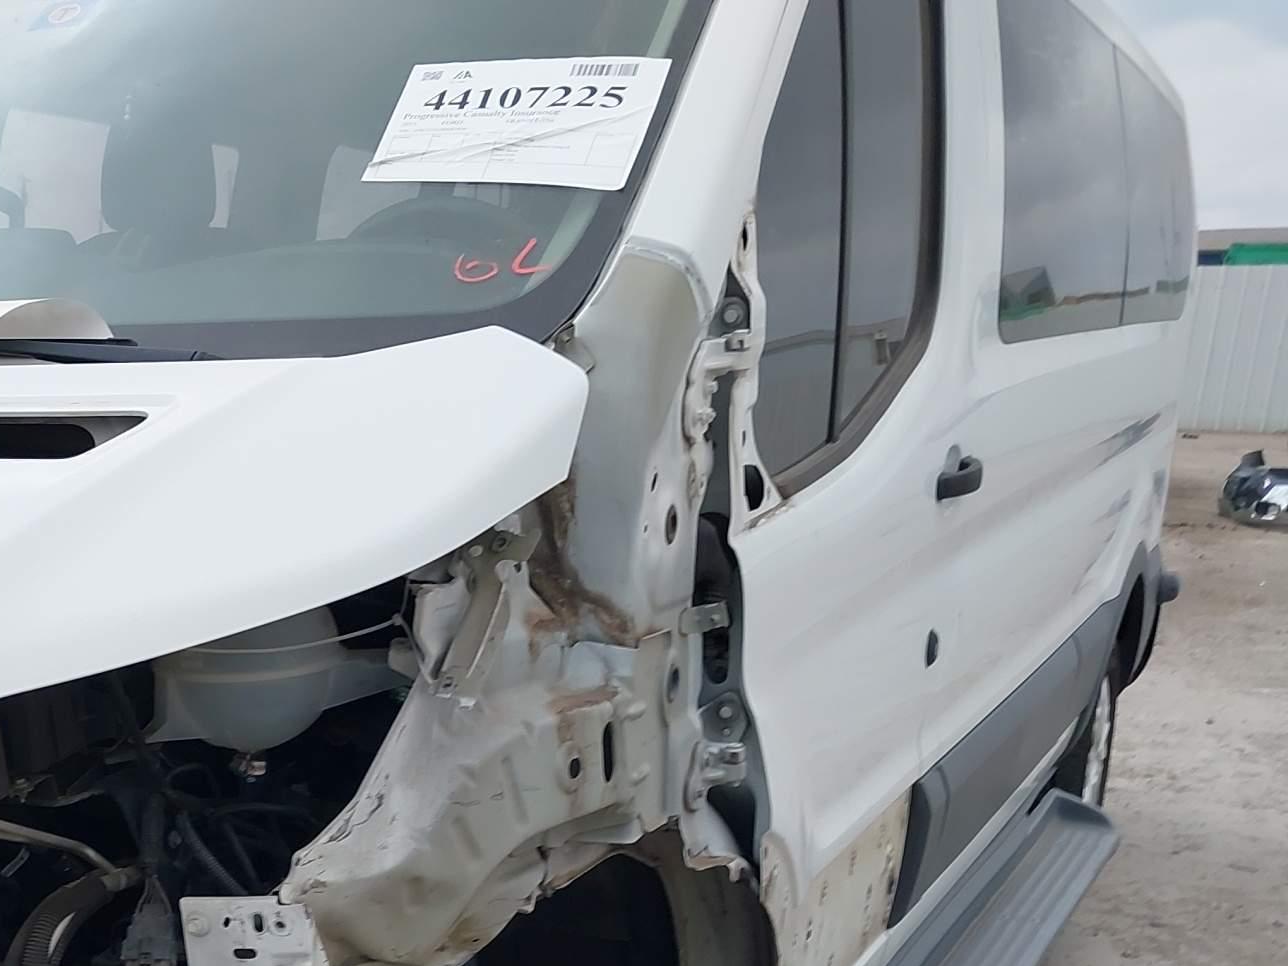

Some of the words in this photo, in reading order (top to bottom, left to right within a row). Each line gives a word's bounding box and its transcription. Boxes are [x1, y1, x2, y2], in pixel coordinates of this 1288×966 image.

[423, 86, 628, 111] 44107225
[402, 112, 460, 121] Progressive
[463, 109, 507, 119] Casualty
[510, 109, 561, 117] Insurance
